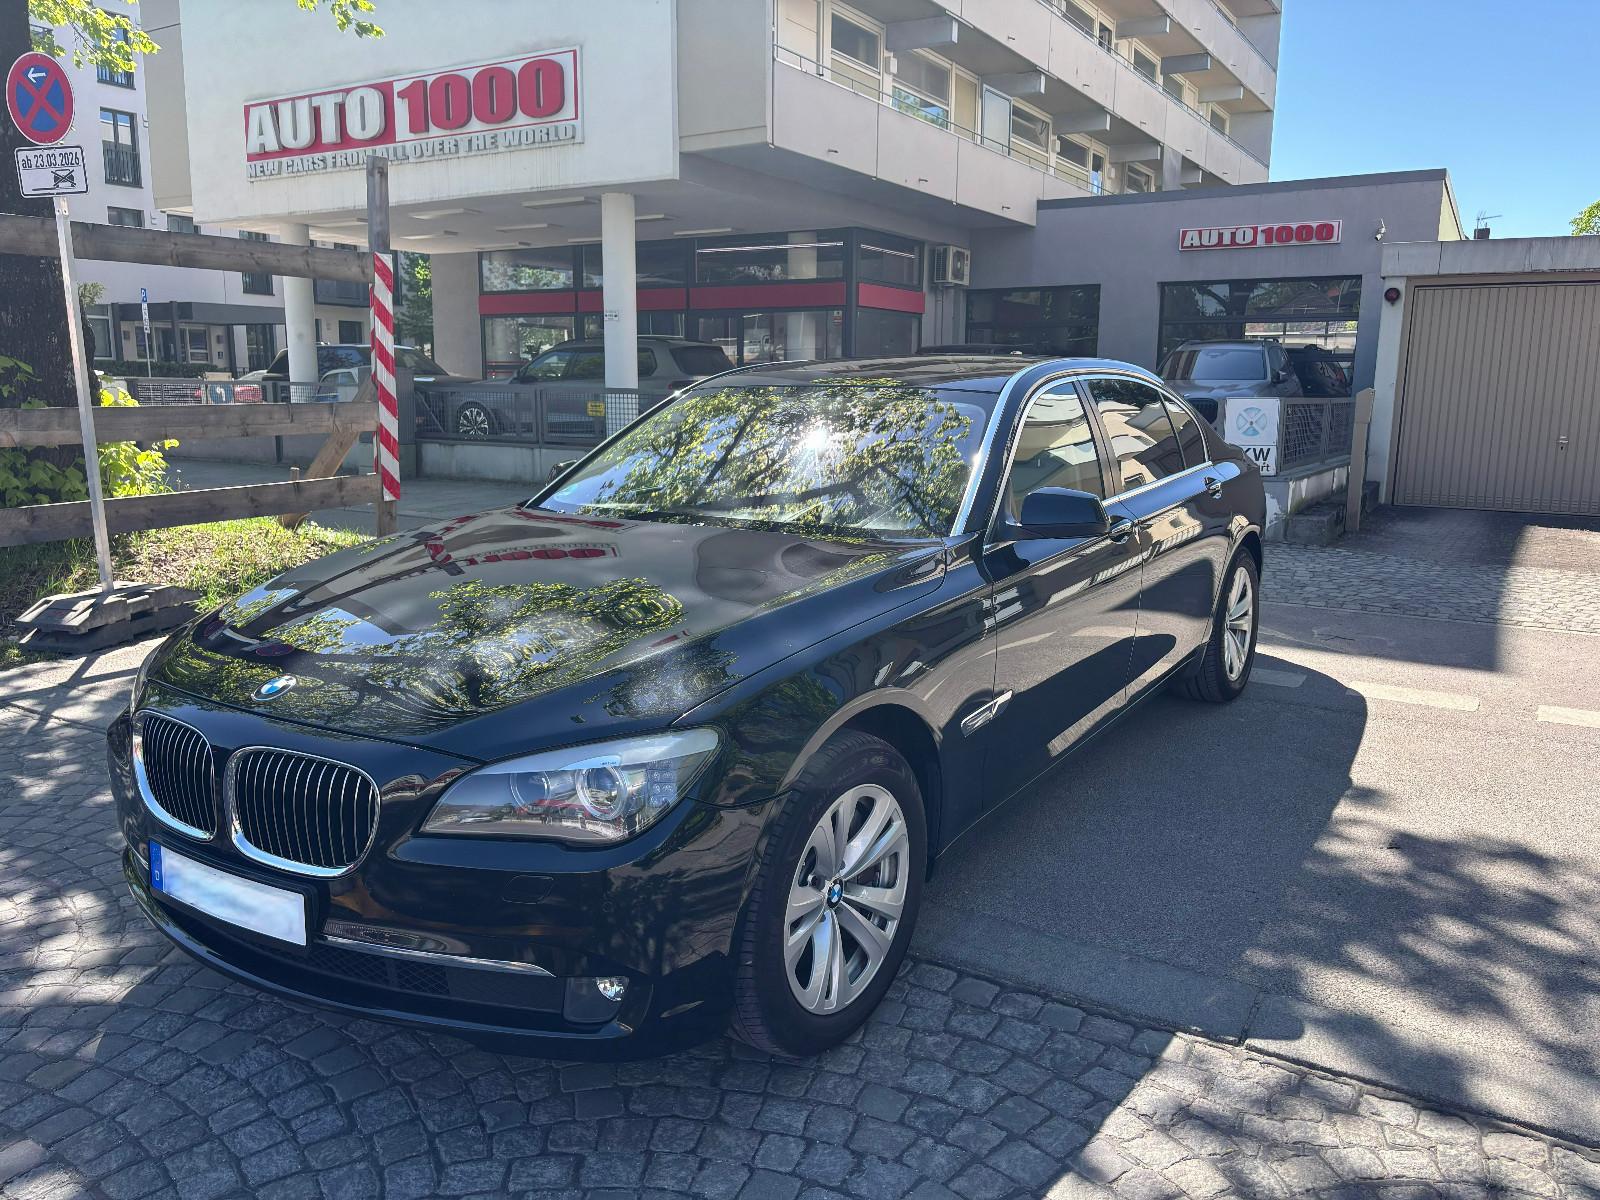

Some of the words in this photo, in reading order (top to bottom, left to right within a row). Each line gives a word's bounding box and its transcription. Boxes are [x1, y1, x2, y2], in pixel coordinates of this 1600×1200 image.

[246, 87, 387, 155] AUTO
[397, 58, 566, 134] 1000
[22, 155, 33, 168] ab
[34, 151, 80, 168] 23.03.2026
[248, 160, 281, 178] NEW
[286, 156, 327, 174] CARS
[411, 136, 458, 158] OVER
[459, 132, 499, 151] THE
[498, 123, 576, 147] WORLD
[1183, 227, 1255, 247] AUTO
[1261, 222, 1335, 244] 1000
